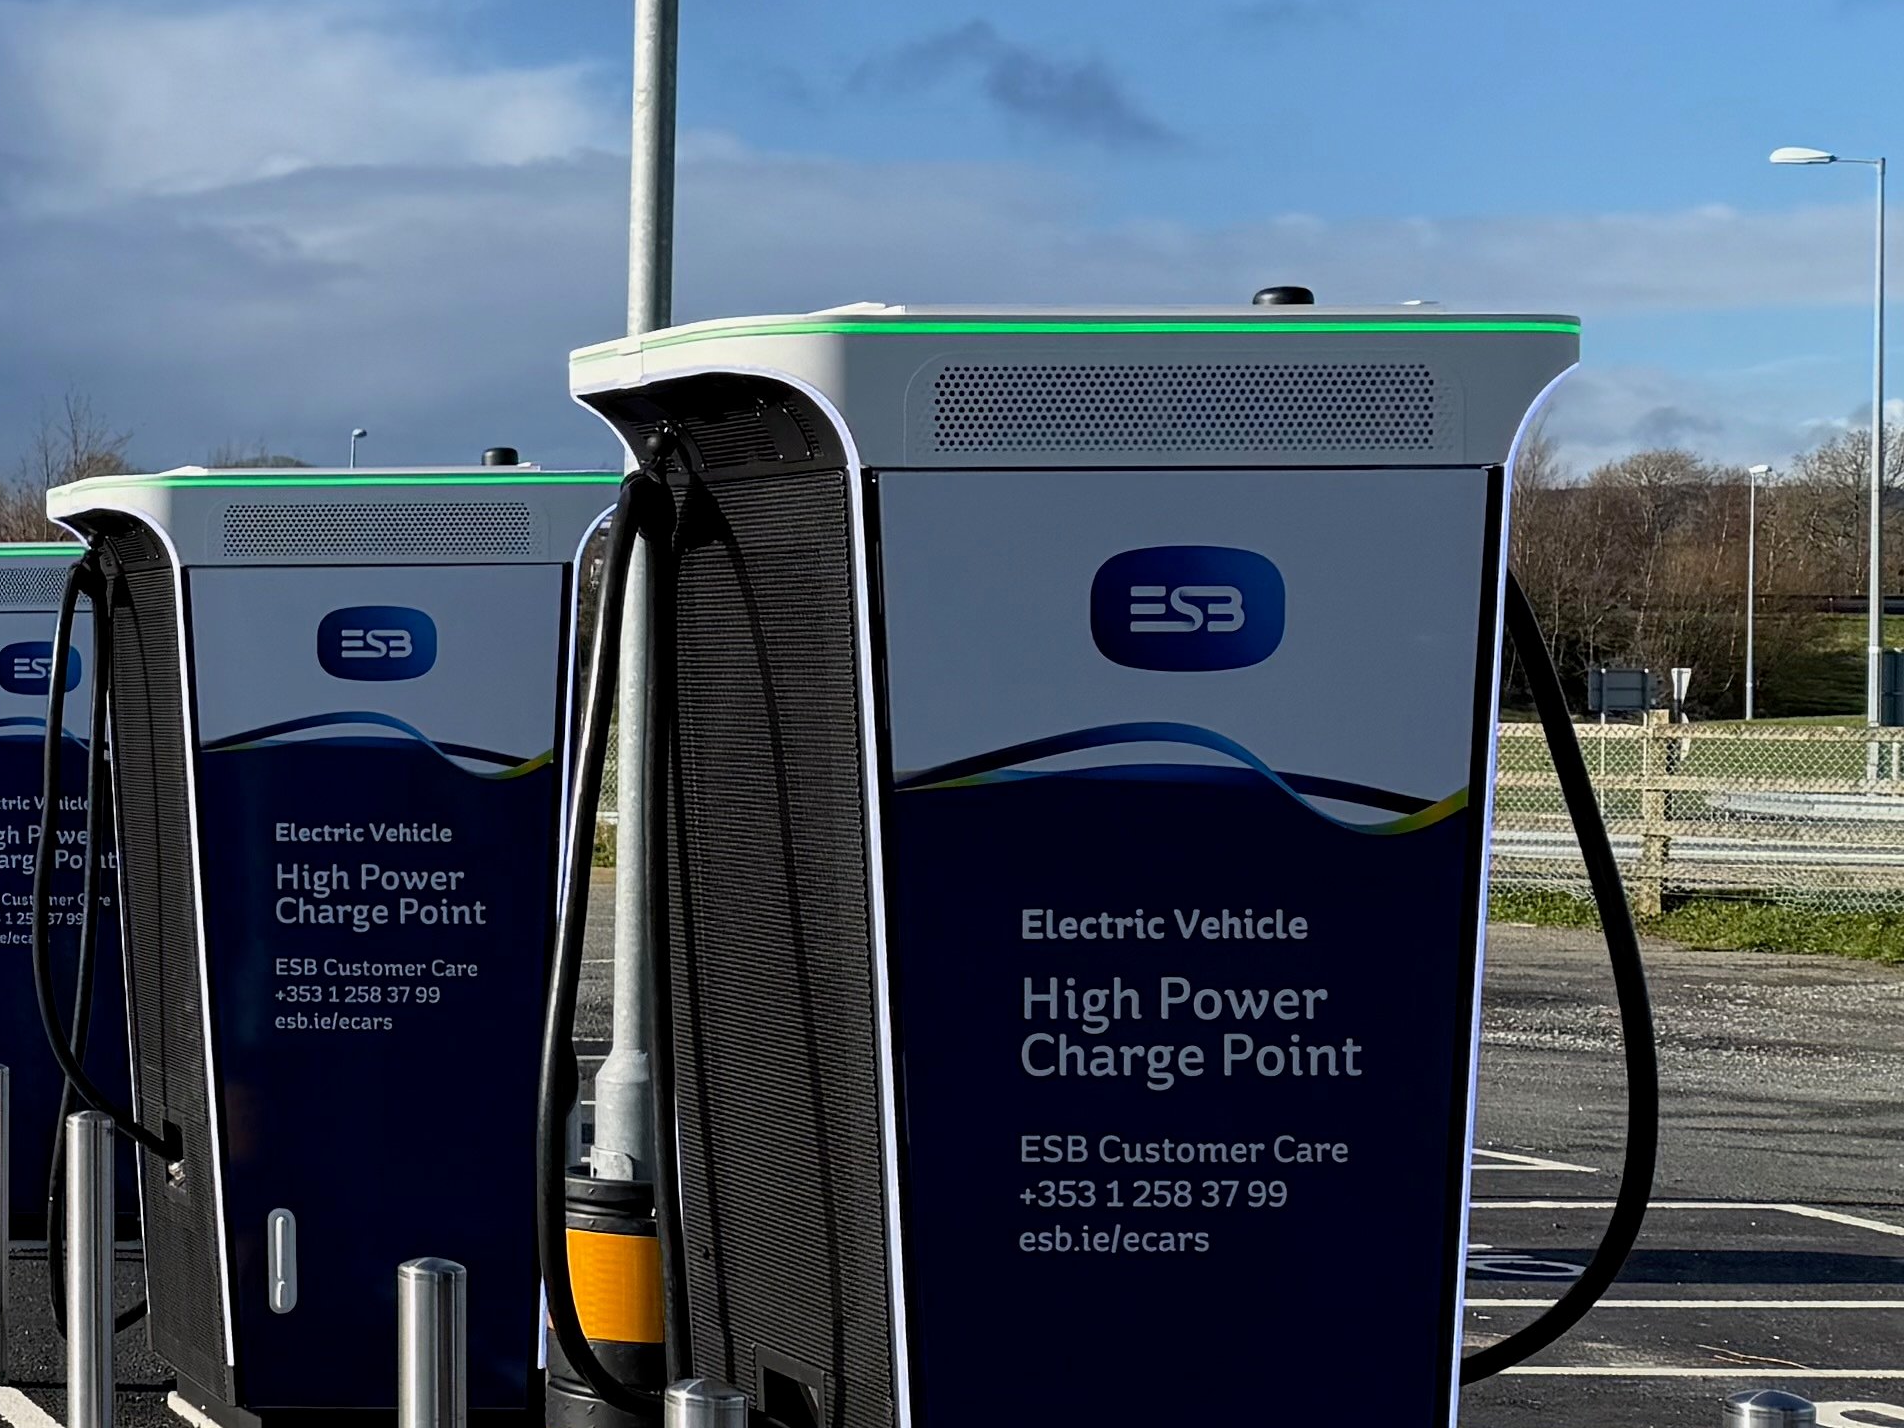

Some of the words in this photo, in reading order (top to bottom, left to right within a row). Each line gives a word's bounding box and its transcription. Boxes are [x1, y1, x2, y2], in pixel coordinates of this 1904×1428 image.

[1130, 586, 1245, 632] ESB
[341, 629, 413, 658] ESB
[14, 658, 52, 679] ES
[28, 824, 89, 845] Pwe
[275, 822, 364, 843] Electric
[368, 822, 453, 843] Vehicle
[276, 863, 350, 899] High
[360, 863, 465, 891] Power
[1, 892, 74, 906] Custmer
[5, 912, 13, 925] 1
[16, 912, 34, 925] 25
[275, 897, 389, 933] Charge
[399, 897, 487, 925] Point
[1021, 908, 1165, 940] Electric
[1173, 908, 1309, 940] Vehicle
[275, 957, 318, 976] ESB
[323, 958, 427, 977] Customer
[431, 959, 478, 977] Care
[275, 985, 323, 1003] +353
[328, 985, 340, 1003] 1
[344, 985, 382, 1004] 258
[386, 985, 411, 1004] 37
[415, 986, 441, 1004] 99
[1023, 976, 1143, 1033] High
[1160, 976, 1329, 1021] Power
[274, 1011, 393, 1031] esb.ie/ecars
[1021, 1033, 1205, 1091] Charge
[1223, 1033, 1363, 1077] Point
[1021, 1134, 1089, 1163] ESB
[1098, 1134, 1266, 1164] Customer
[1273, 1134, 1349, 1163] Care
[1019, 1180, 1097, 1208] +353
[1106, 1179, 1124, 1208] 1
[1132, 1180, 1193, 1208] 258
[1201, 1180, 1240, 1208] 37
[1247, 1179, 1288, 1208] 99
[1019, 1223, 1210, 1254] esb.ie/ecars
